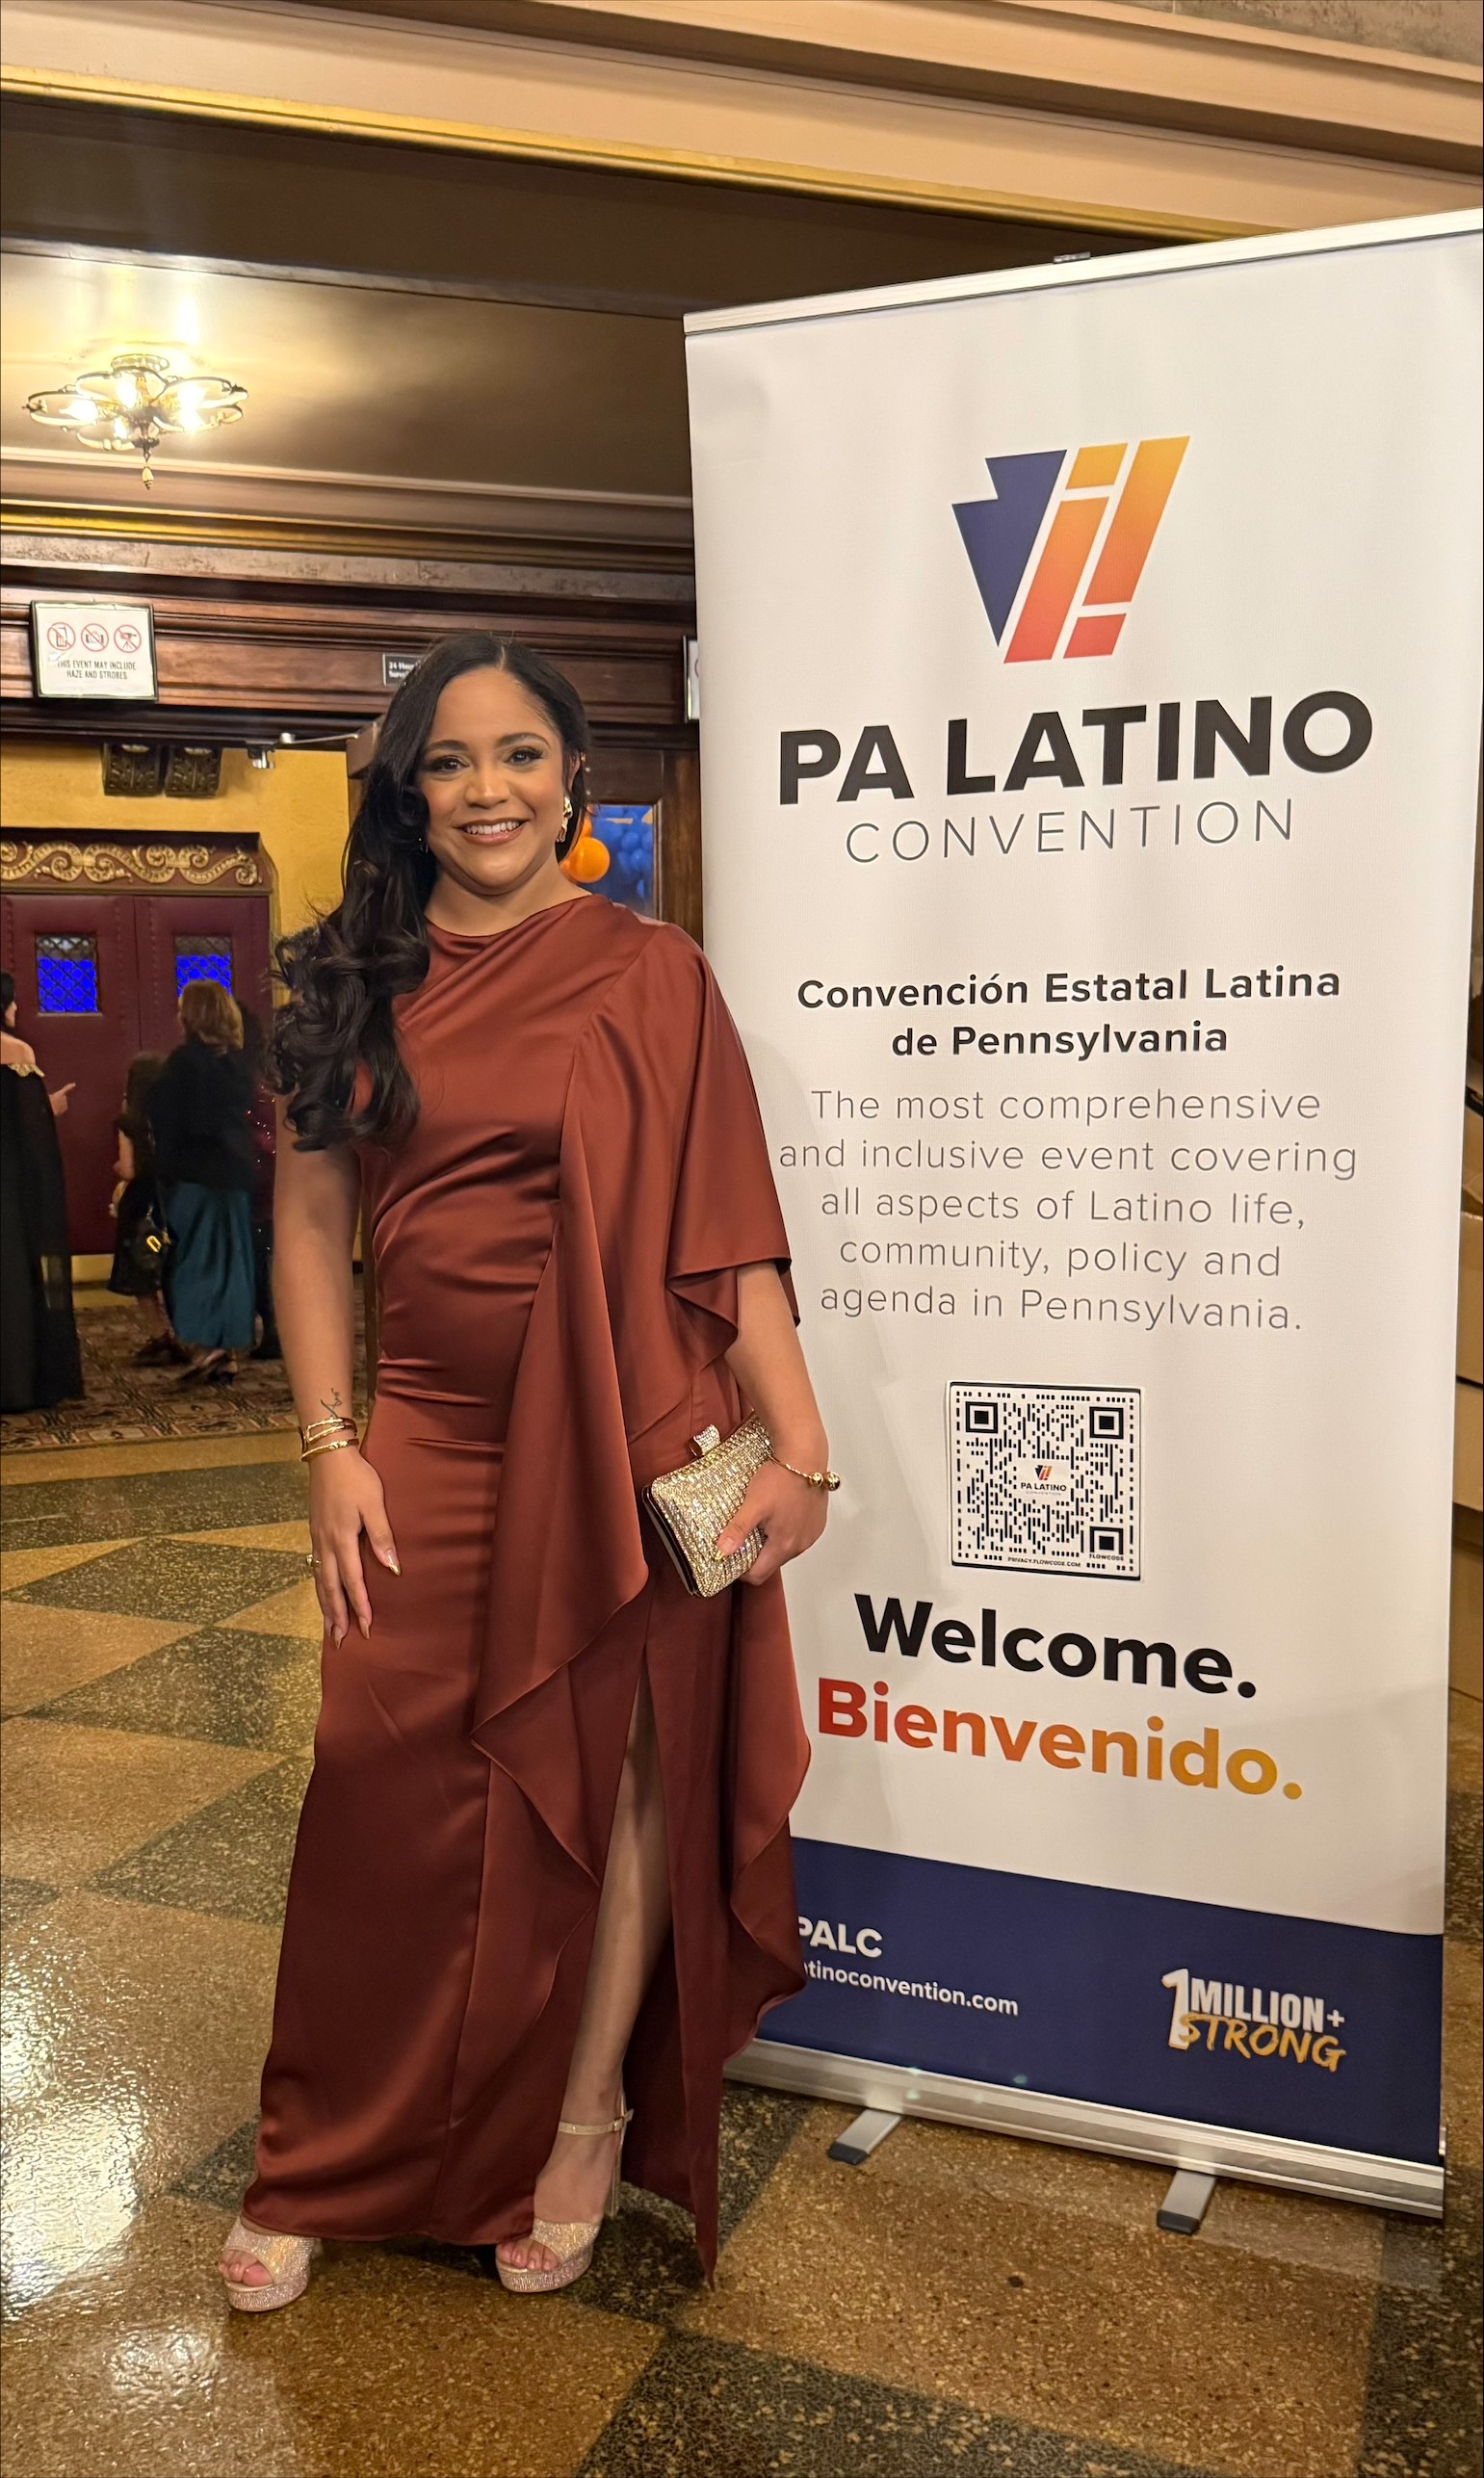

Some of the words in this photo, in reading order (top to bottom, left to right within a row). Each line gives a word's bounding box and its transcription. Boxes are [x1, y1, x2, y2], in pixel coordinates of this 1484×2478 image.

[73, 661, 92, 669] EVENT
[110, 662, 137, 671] INCLUDE
[99, 671, 128, 680] STROBES
[780, 725, 914, 805] PA
[947, 691, 1372, 796] LATINO
[846, 798, 1291, 862] CONVENTION
[798, 974, 1027, 1008] Convención
[1047, 970, 1186, 1002] Estatal
[1207, 965, 1339, 998] Latina
[893, 1028, 937, 1056] de
[953, 1021, 1226, 1060] Pennsylvania
[812, 1091, 878, 1118] The
[898, 1092, 983, 1118] most
[1001, 1088, 1319, 1126] comprehensive
[780, 1139, 844, 1166] and
[864, 1139, 1023, 1168] inclusive
[1042, 1142, 1153, 1170] event
[1171, 1142, 1355, 1180] covering
[822, 1187, 858, 1214] all
[877, 1192, 1018, 1223] aspects
[1037, 1190, 1074, 1219] of
[1092, 1191, 1211, 1222] Latino
[1233, 1193, 1303, 1229] life,
[841, 1239, 1049, 1276] community,
[1069, 1242, 1186, 1281] policy
[1205, 1246, 1279, 1276] and
[821, 1286, 954, 1317] agenda
[974, 1289, 1002, 1317] in
[1023, 1290, 1300, 1330] Pennsylvania.
[854, 1593, 1257, 1698] Welcome.
[820, 1680, 1302, 1800] Bienvenido.
[804, 1961, 1018, 2015] tinoconvention.com
[1180, 2012, 1347, 2073] STRONG
